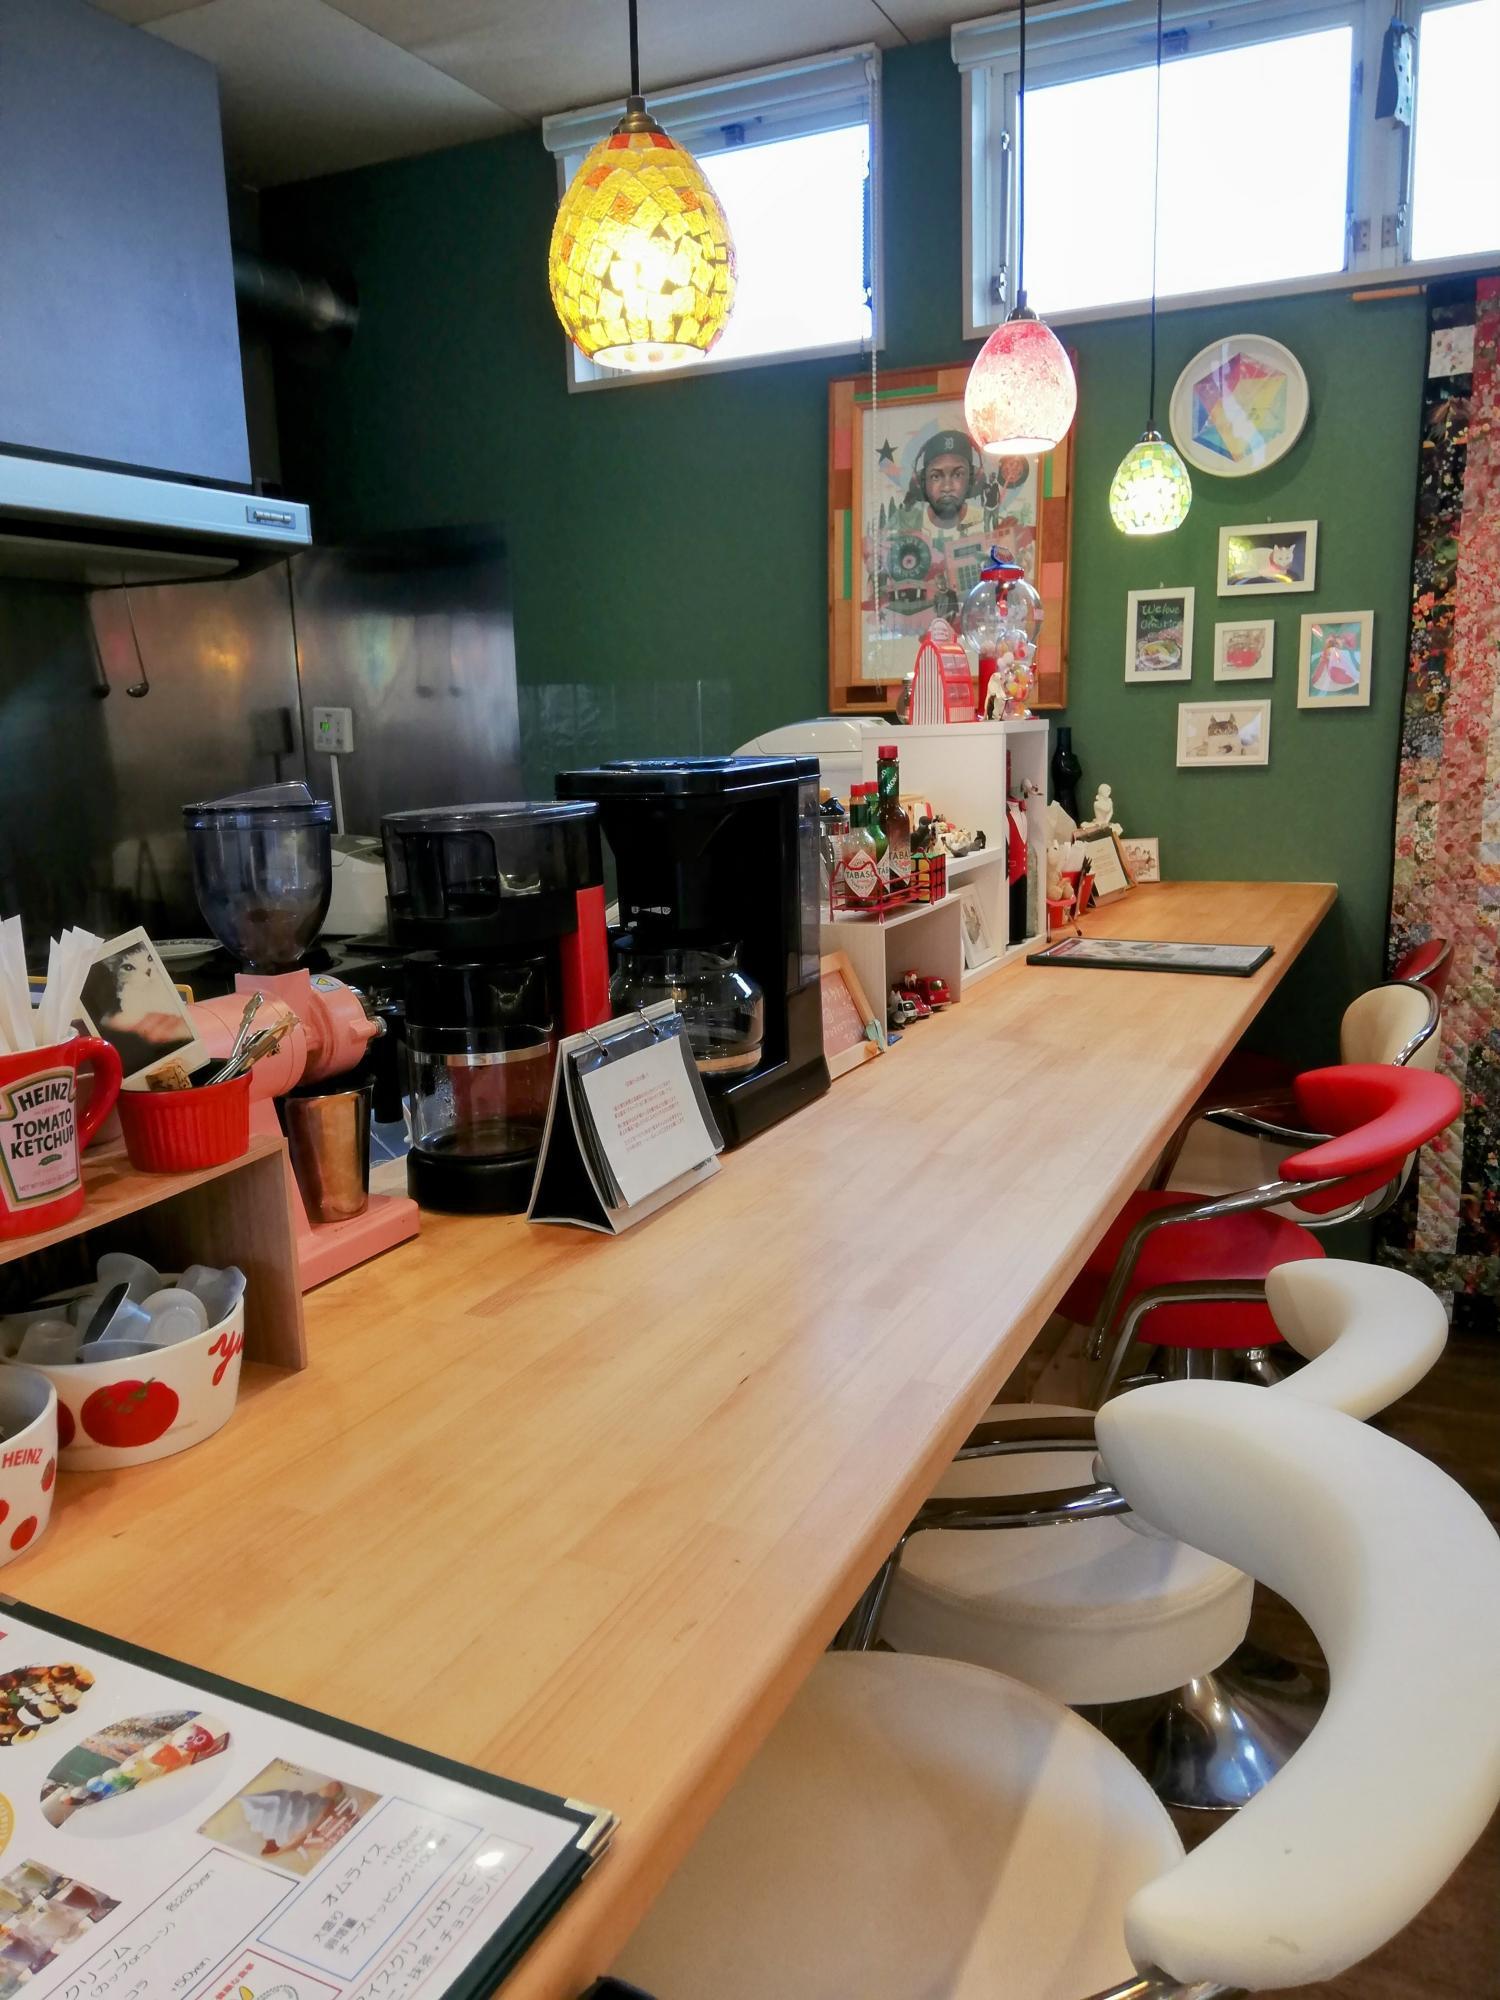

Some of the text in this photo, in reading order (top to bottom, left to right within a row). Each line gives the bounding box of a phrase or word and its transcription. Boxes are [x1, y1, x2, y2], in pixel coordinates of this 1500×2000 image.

[17, 1082, 68, 1112] HEINZ
[12, 1108, 72, 1140] TOMATO
[11, 1125, 74, 1160] KETCHUP
[1, 1448, 43, 1469] HEINZ
[320, 1843, 385, 1907] オムライス
